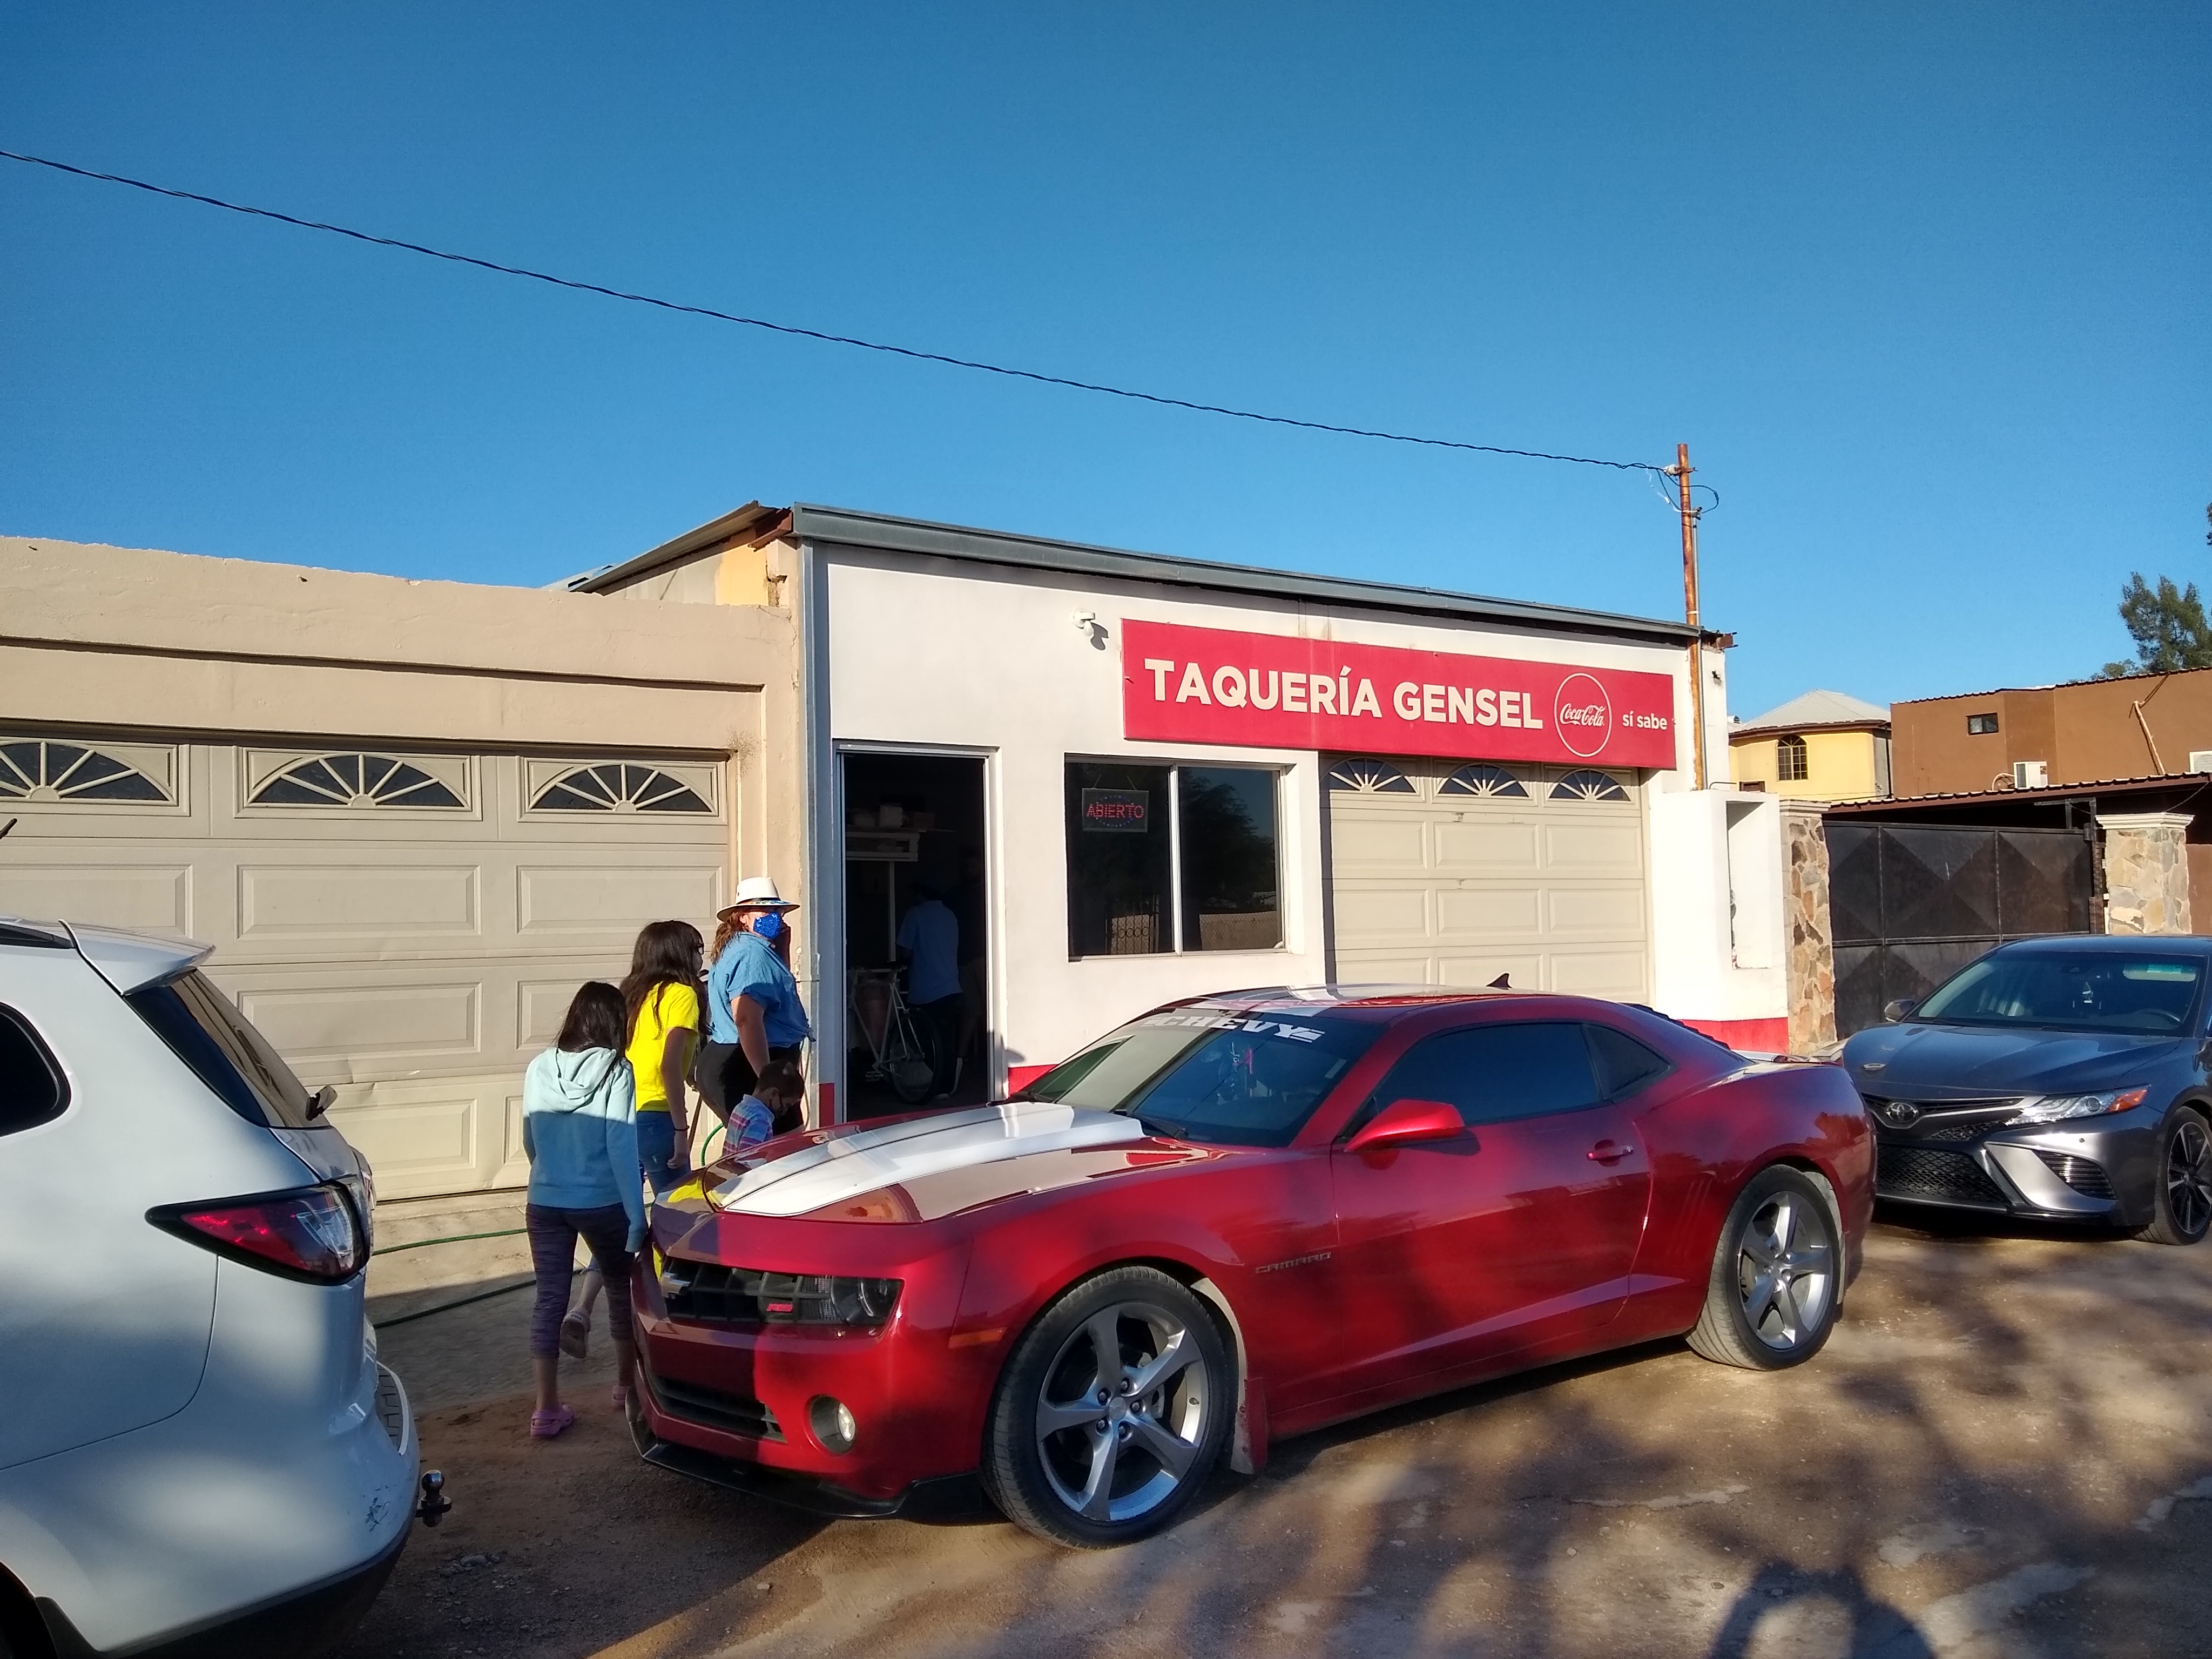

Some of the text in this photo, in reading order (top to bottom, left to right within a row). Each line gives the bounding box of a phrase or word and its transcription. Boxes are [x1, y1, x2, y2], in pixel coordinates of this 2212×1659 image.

[1144, 658, 1543, 729] TAQUERÍA GENSEL
[1560, 703, 1606, 727] Coca-Cola
[1622, 711, 1667, 730] sí sabe
[1087, 804, 1144, 819] ABIERTO
[1148, 1016, 1325, 1043] CHEVY
[1256, 1252, 1332, 1274] CAMARO
